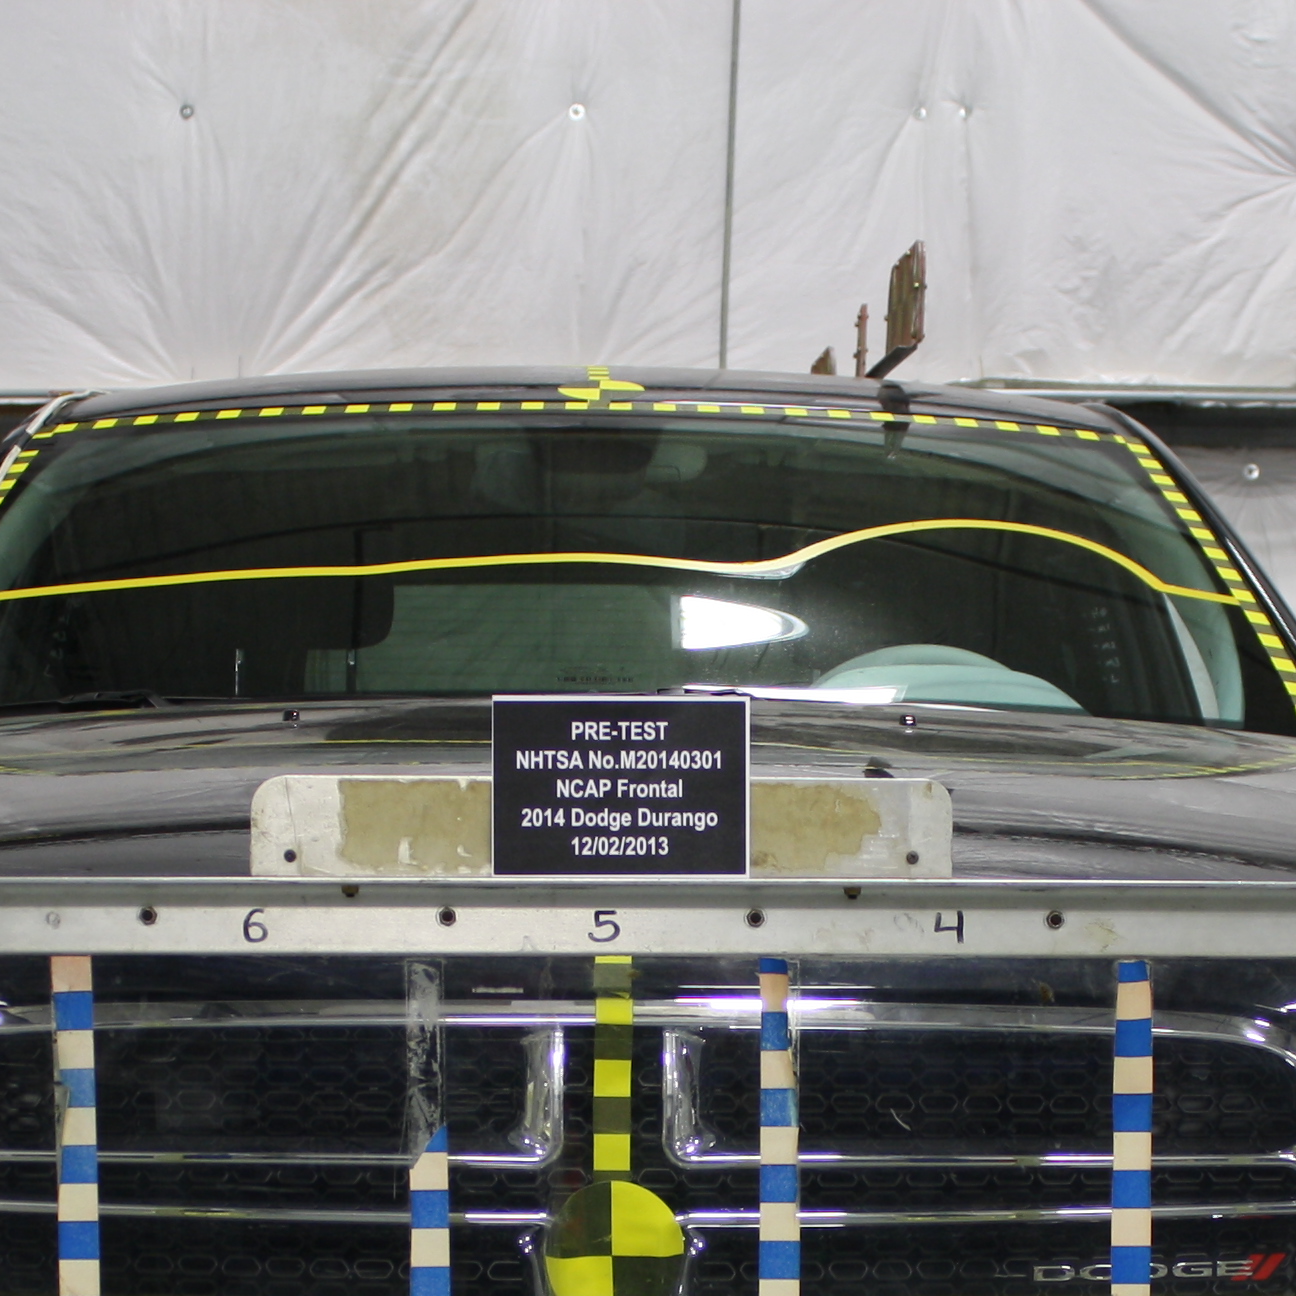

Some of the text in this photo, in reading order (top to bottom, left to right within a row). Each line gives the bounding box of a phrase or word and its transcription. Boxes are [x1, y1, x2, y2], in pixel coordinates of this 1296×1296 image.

[570, 721, 669, 741] PRE-TEST
[515, 750, 722, 770] NHTSA No.M20140301
[556, 778, 684, 798] NCAP Frontal
[521, 807, 719, 831] 2014 Dodge Durango
[570, 836, 670, 856] 12/02/2013
[241, 907, 271, 944] 6
[587, 909, 623, 943] 5
[933, 909, 965, 944] 4
